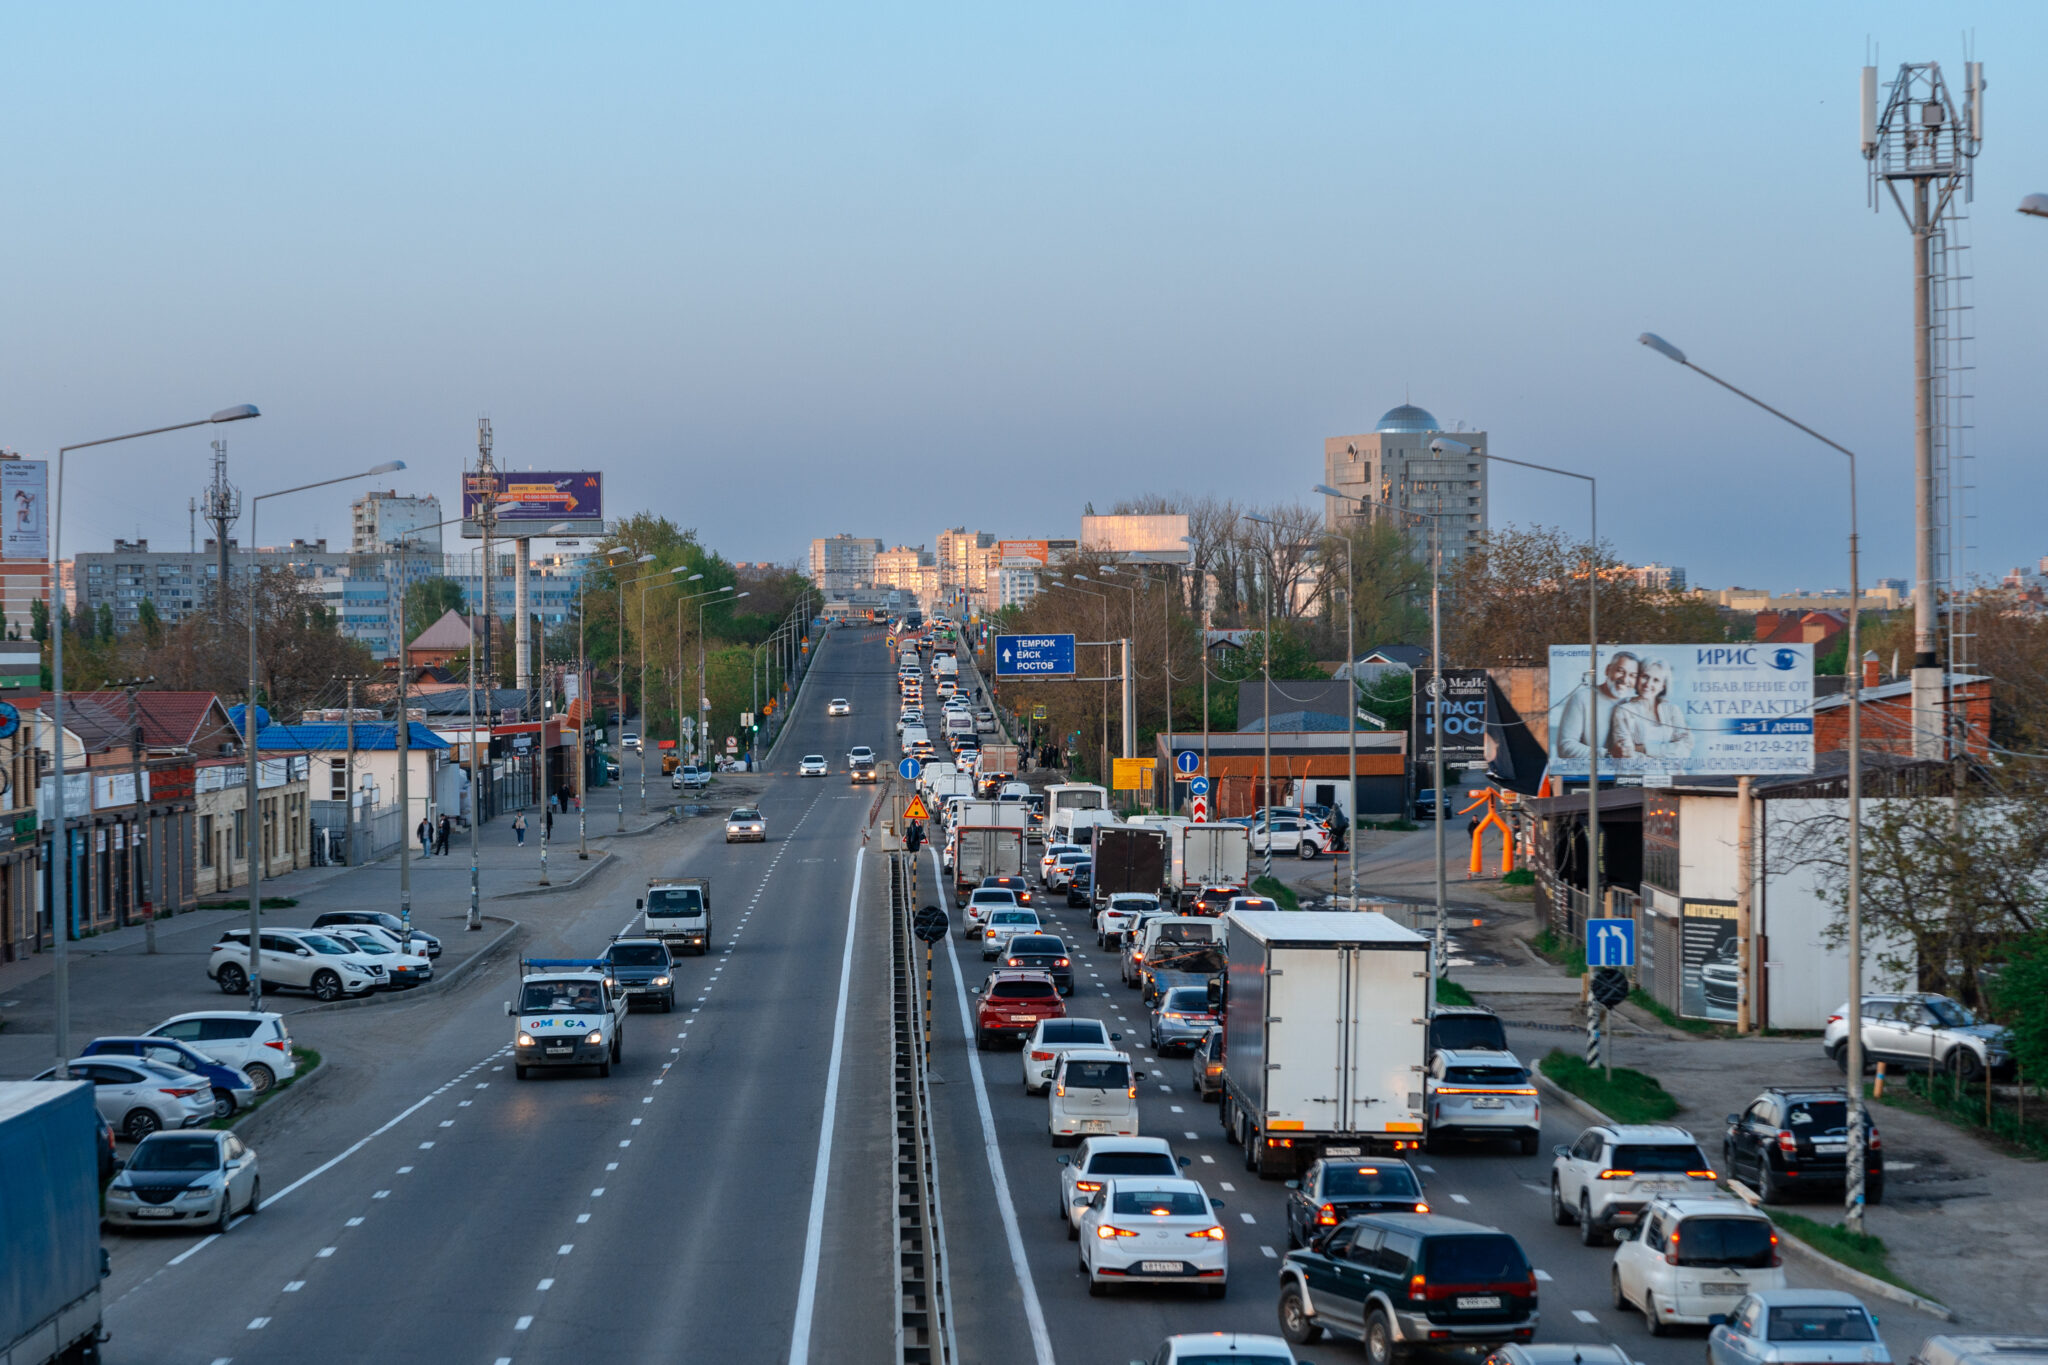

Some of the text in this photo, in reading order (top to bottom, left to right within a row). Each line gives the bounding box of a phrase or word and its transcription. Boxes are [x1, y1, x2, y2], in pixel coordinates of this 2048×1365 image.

[1017, 639, 1056, 648] ТЕМРЮК
[1016, 650, 1041, 659] ЕЙСК
[1551, 649, 1606, 657] iris-centeru
[1696, 647, 1758, 665] ИРИС
[1017, 661, 1054, 670] РОСТОВ
[1693, 681, 1809, 692] ИЗБАВЛЕНИЕ ОТ
[1686, 699, 1809, 714] КАТАРАКТЫ
[1741, 720, 1810, 734] за 1 день
[1744, 740, 1809, 752] 212-9-212
[530, 1018, 587, 1029] OMEGA
